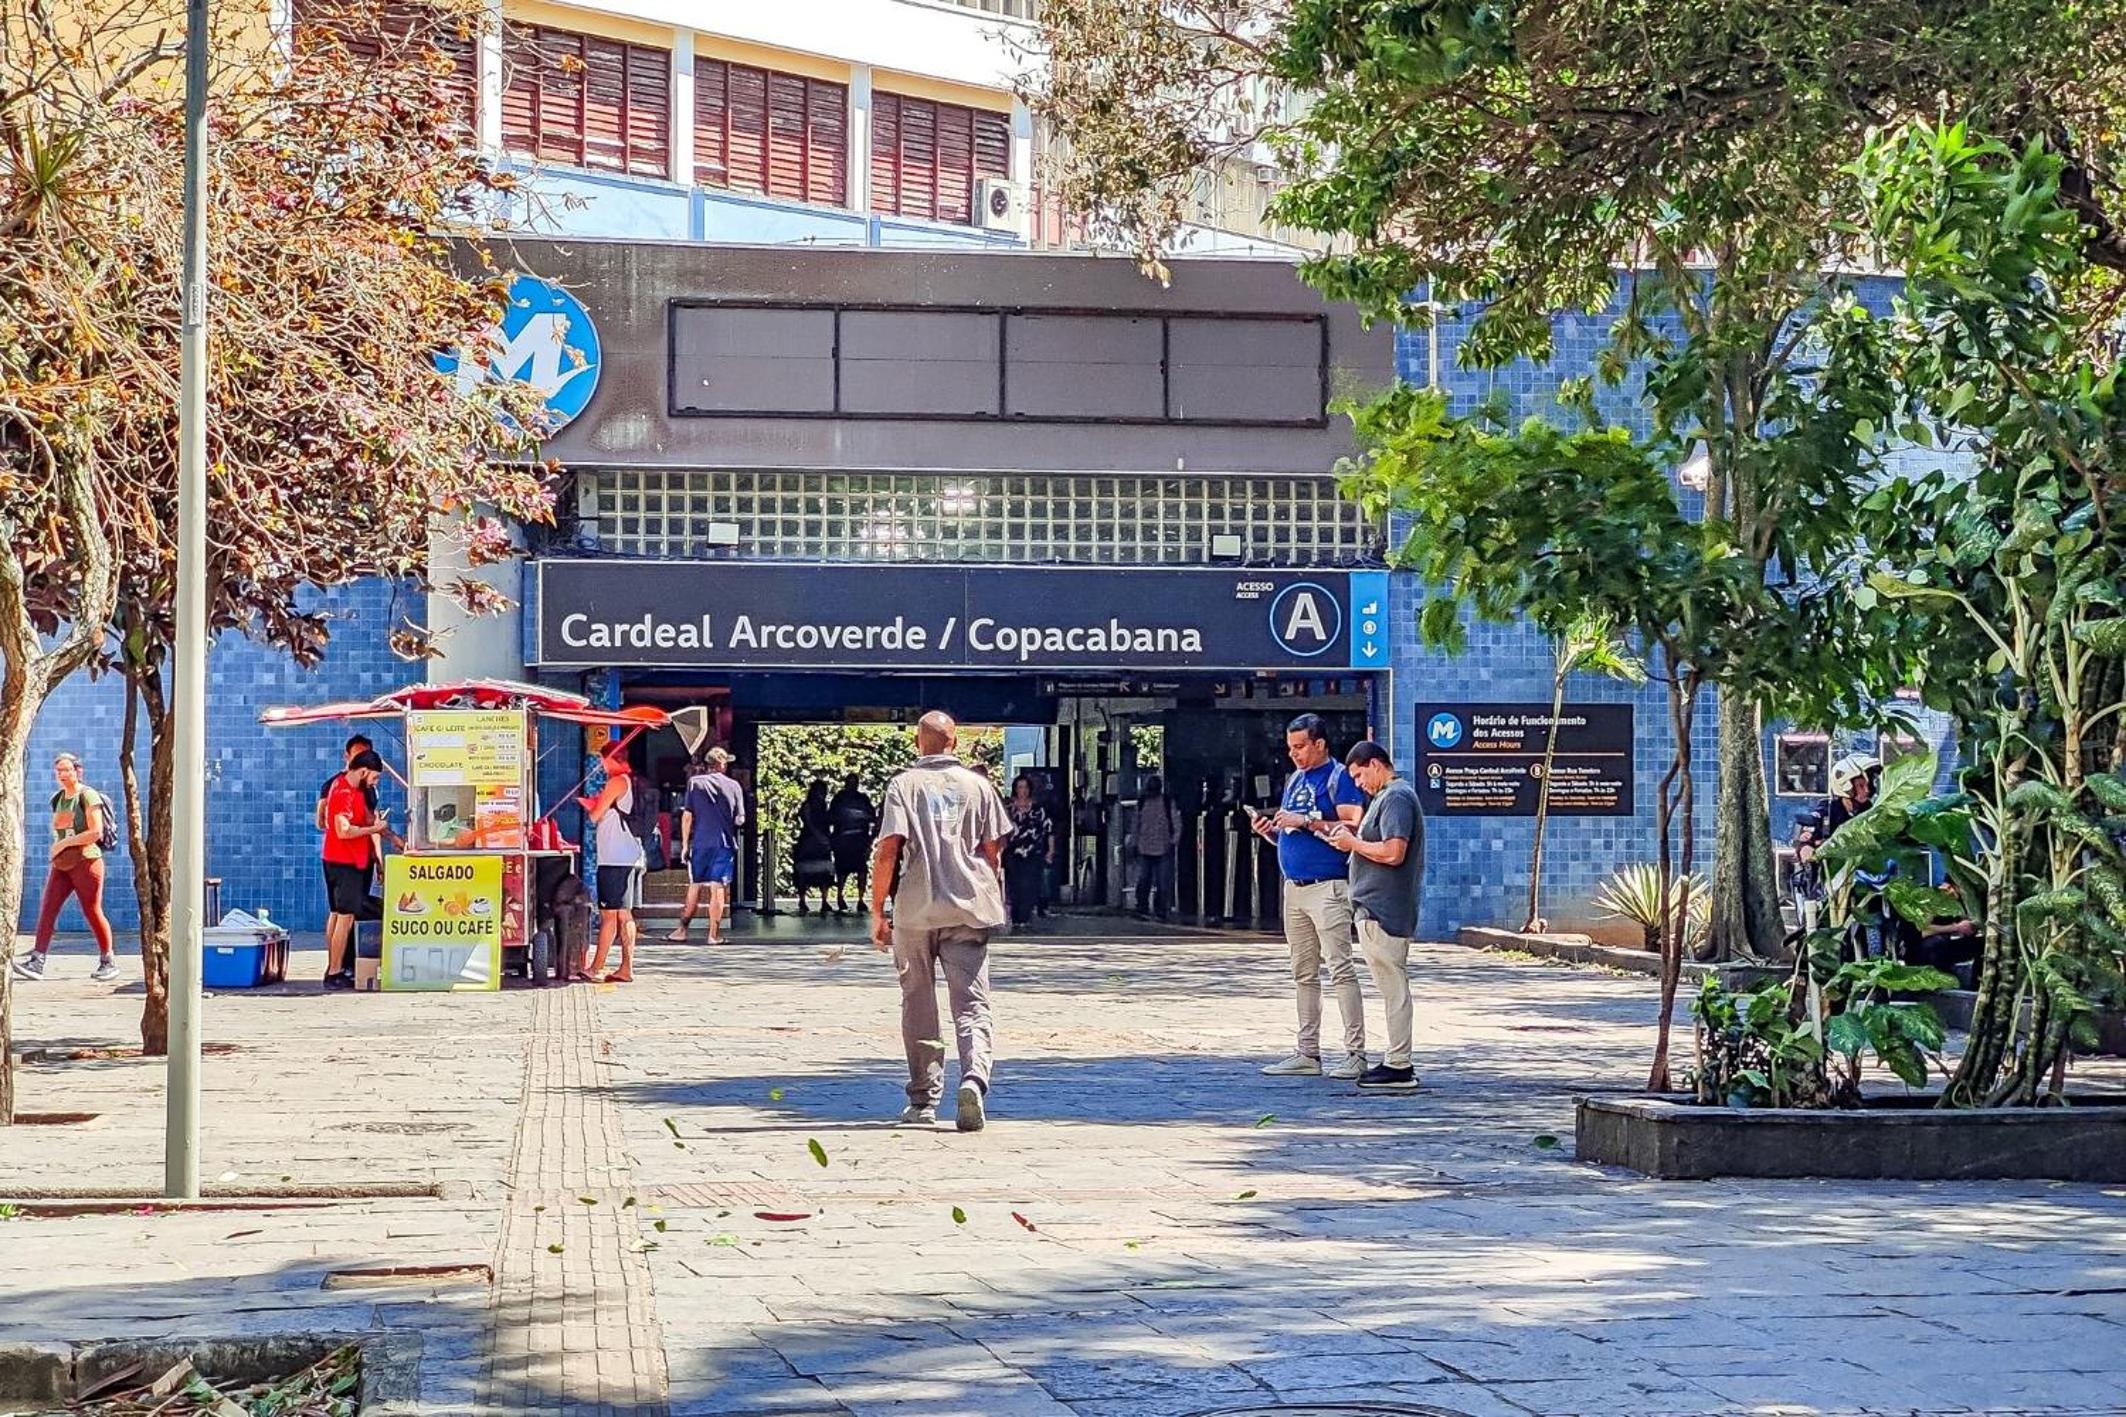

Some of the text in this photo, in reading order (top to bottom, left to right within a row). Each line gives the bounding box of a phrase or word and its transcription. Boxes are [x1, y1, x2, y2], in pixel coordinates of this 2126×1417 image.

[1236, 582, 1274, 591] ACESSO
[1284, 592, 1327, 640] A
[561, 613, 1202, 661] Cardeal Arcoverde / Copacabana
[1473, 715, 1587, 725] Horário de Funcionmento
[1473, 728, 1525, 738] dos Acessos
[409, 865, 474, 880] SALGADO
[390, 915, 493, 935] SUCO OU CAFÉ
